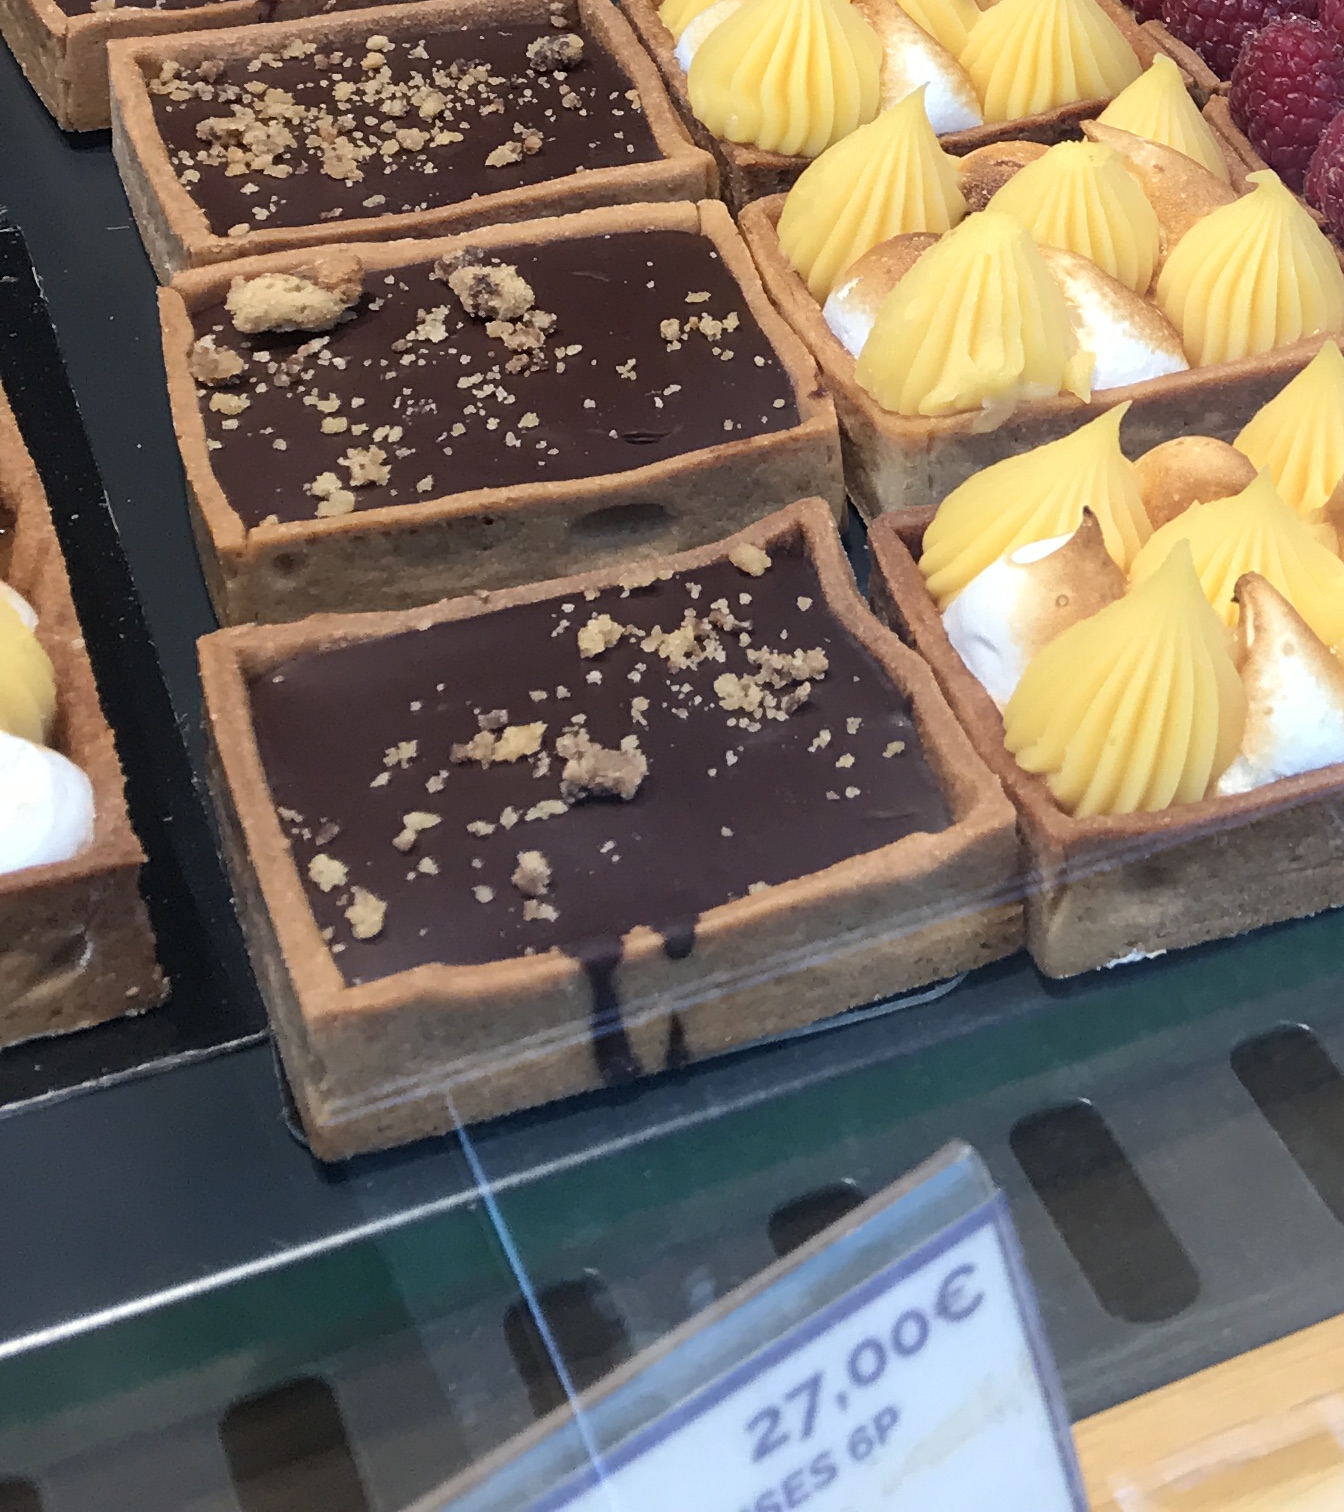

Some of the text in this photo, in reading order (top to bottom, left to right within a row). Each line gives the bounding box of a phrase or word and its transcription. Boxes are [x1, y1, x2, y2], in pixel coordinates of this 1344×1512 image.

[744, 1263, 985, 1463] 27,00€
[742, 1405, 900, 1512] SES 6P
